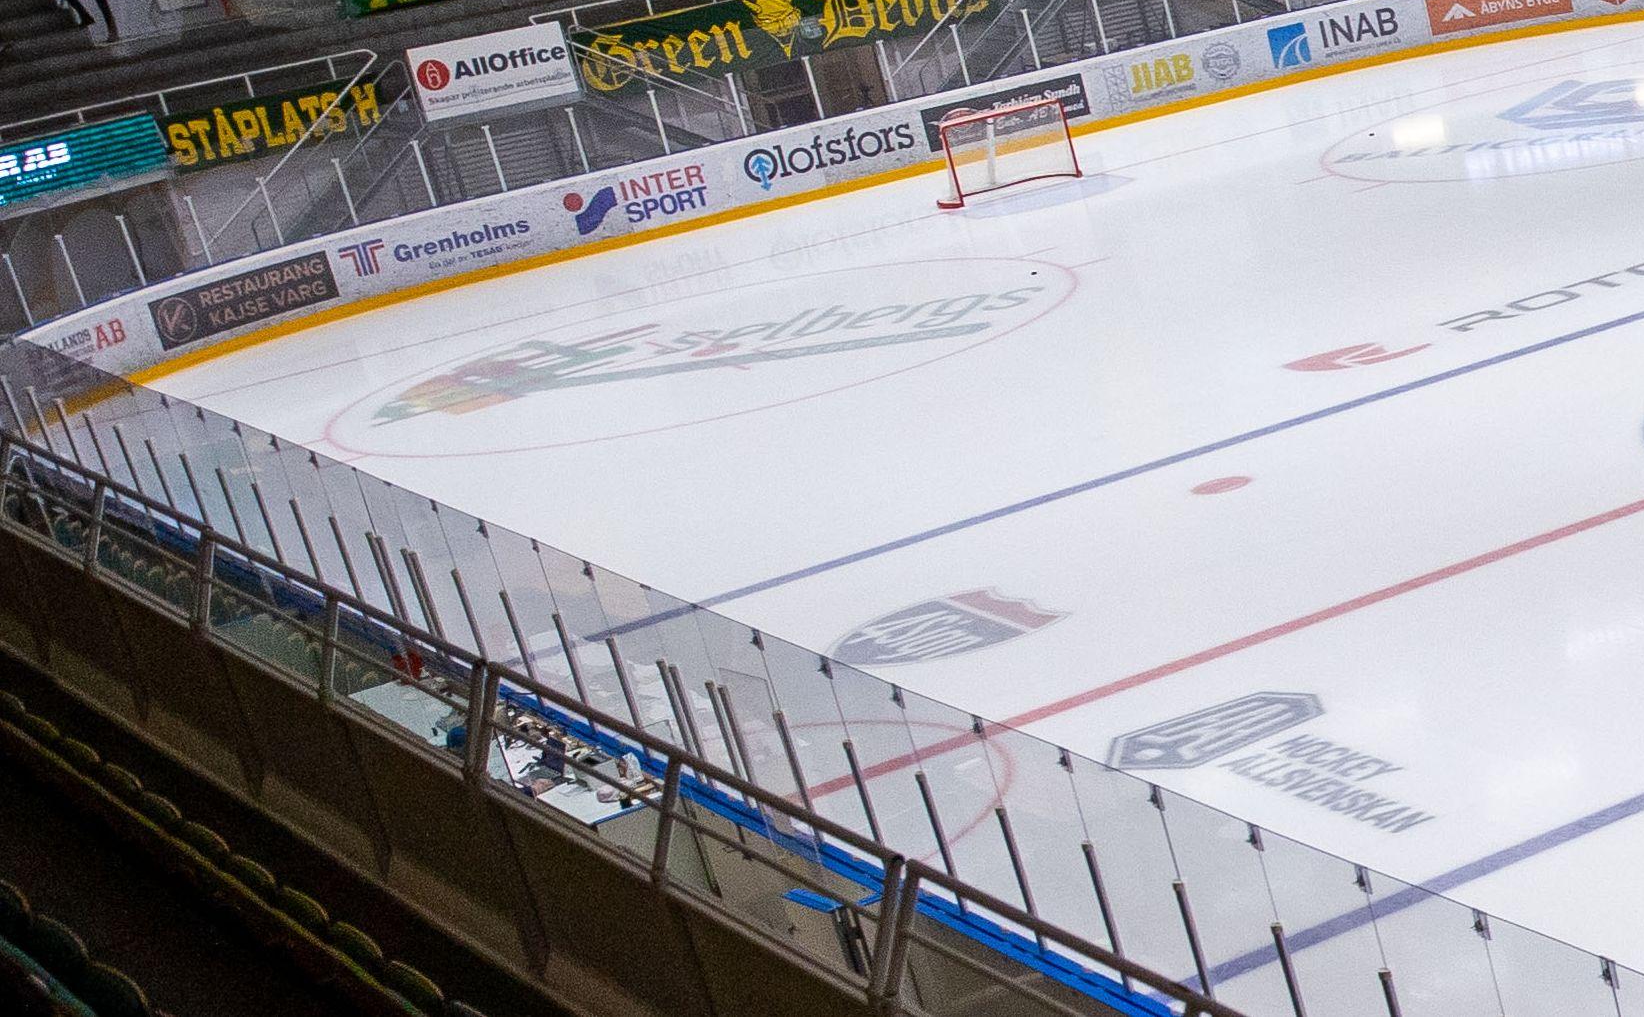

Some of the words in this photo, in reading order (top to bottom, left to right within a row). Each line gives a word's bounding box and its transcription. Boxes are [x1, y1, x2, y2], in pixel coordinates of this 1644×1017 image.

[1319, 6, 1400, 49] INAB
[454, 43, 567, 81] AllOffice
[1131, 52, 1196, 95] JIAB
[167, 89, 349, 167] STÅPLATS
[351, 82, 383, 127] H
[744, 117, 915, 183] Olofsfors
[620, 164, 704, 202] INTER
[626, 185, 708, 225] SPORT
[394, 218, 531, 264] Grenholms
[199, 256, 327, 308] RESTAURANG
[273, 280, 328, 309] VARG
[95, 316, 126, 350] AB
[1272, 733, 1404, 781] HOCKEY
[1219, 753, 1437, 835] ALLSVENSKAN
